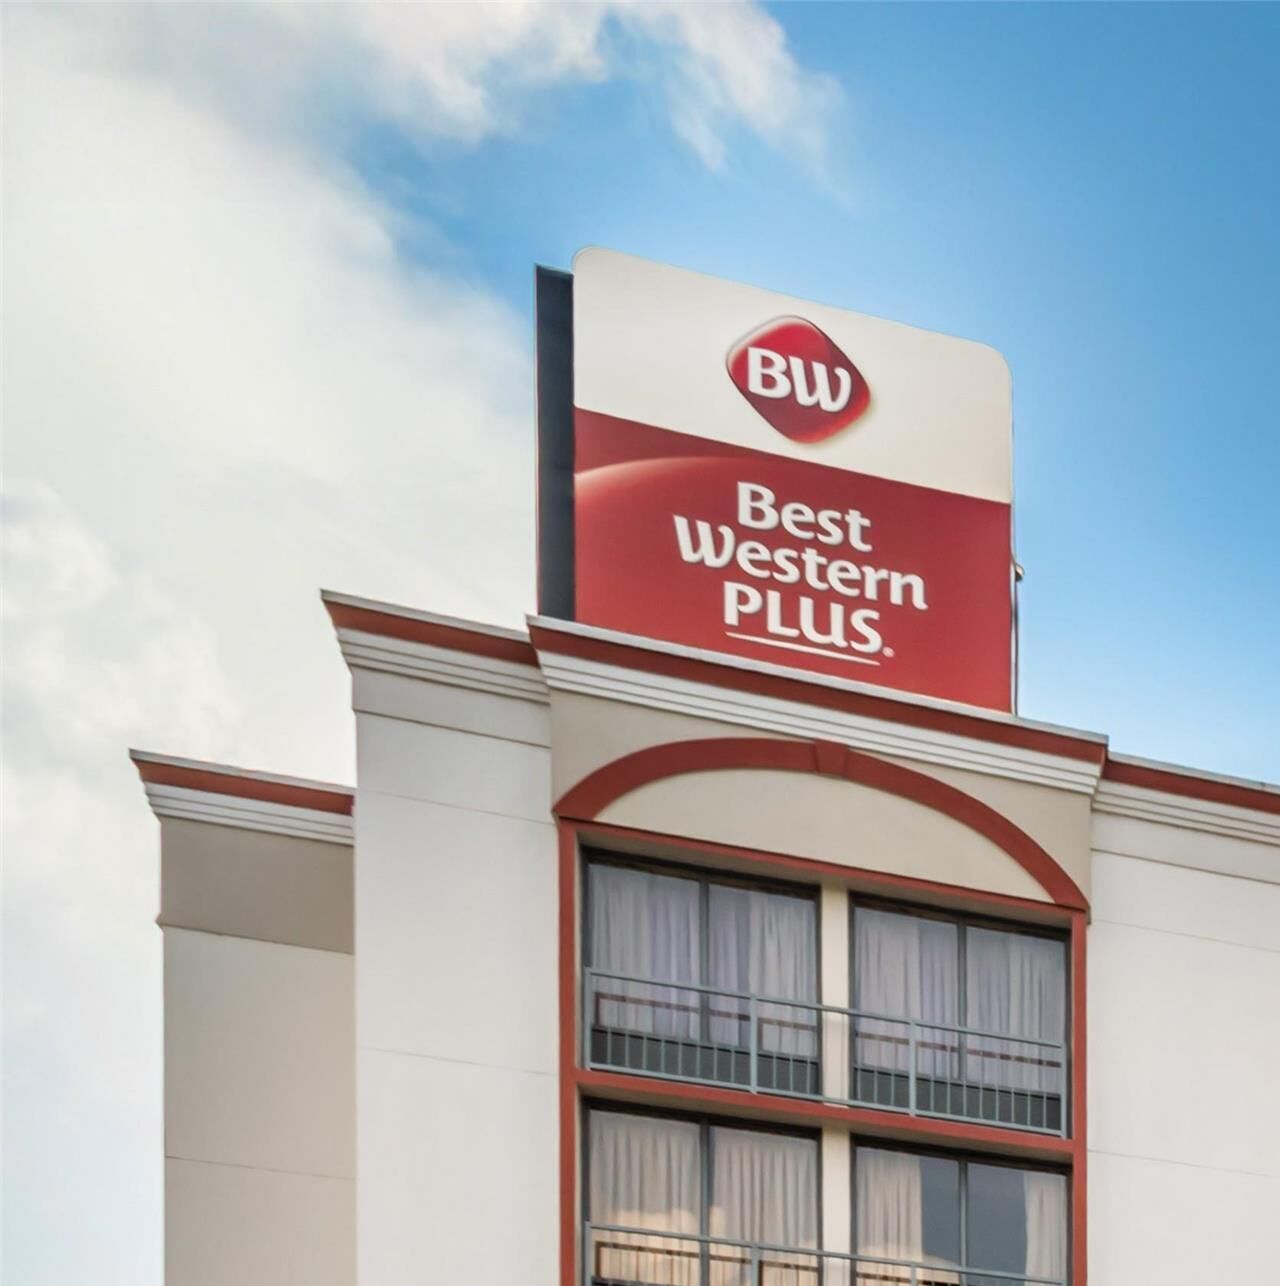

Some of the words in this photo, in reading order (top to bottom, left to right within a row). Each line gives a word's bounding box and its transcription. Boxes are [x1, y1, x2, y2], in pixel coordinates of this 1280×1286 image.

[747, 347, 852, 413] BW
[737, 481, 873, 552] Best
[673, 514, 929, 611] Western
[723, 580, 884, 654] PLUS
